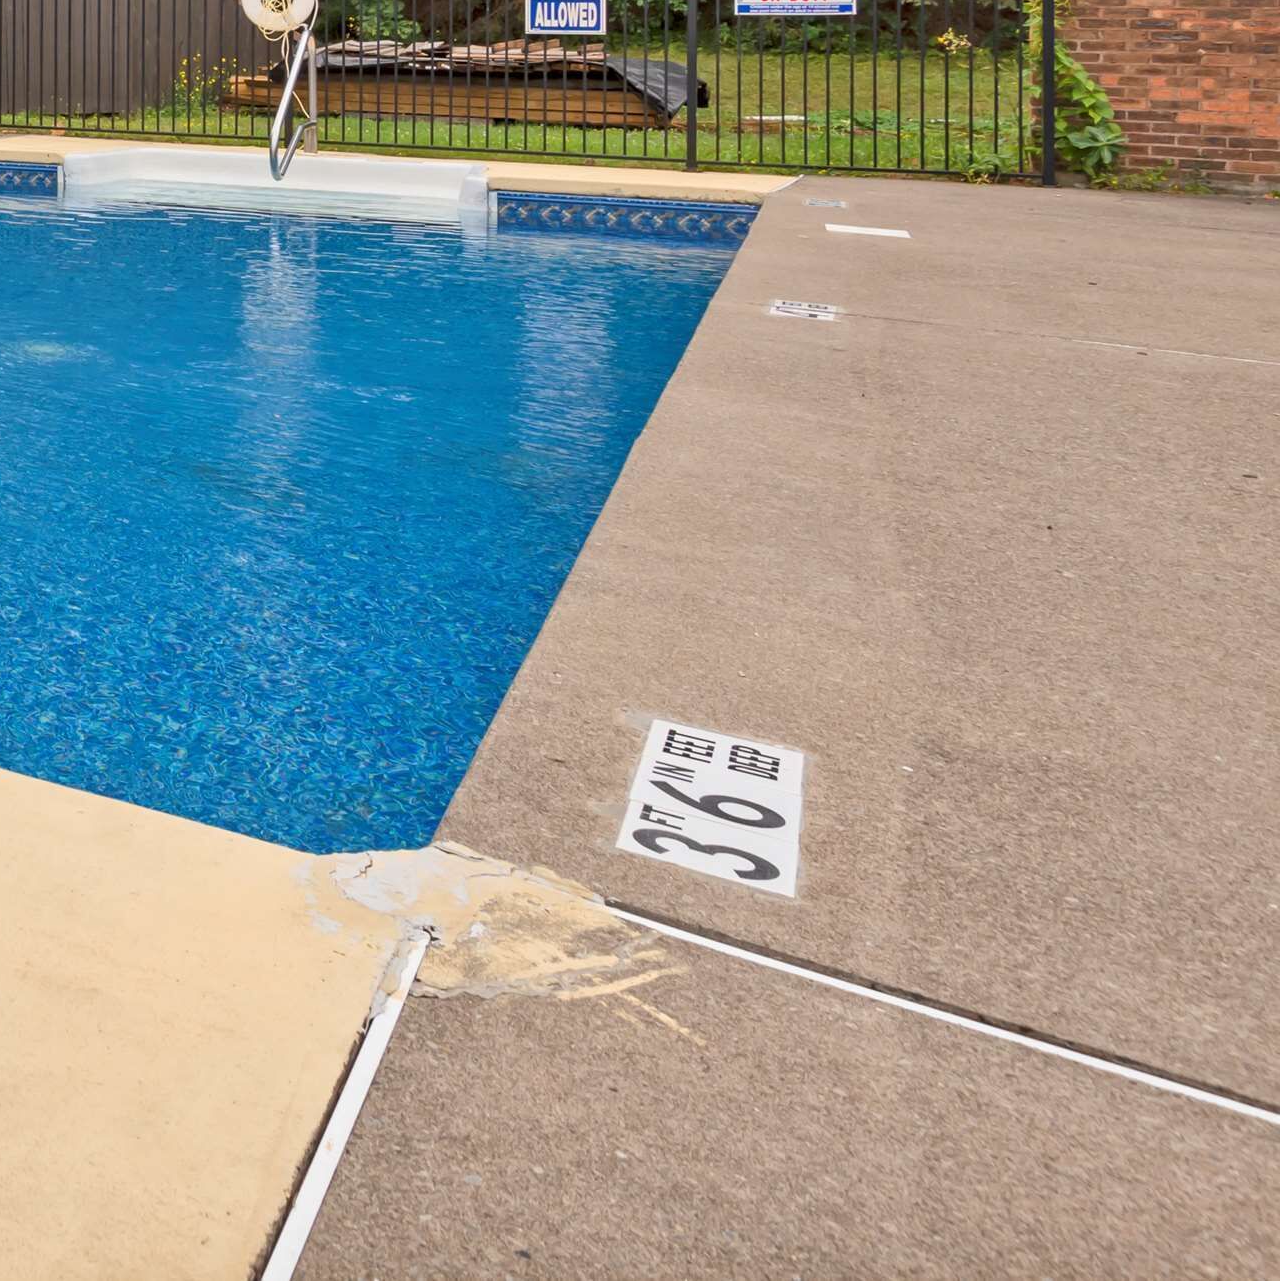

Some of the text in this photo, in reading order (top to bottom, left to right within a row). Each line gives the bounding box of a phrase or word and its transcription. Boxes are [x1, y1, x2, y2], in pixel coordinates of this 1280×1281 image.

[535, 2, 598, 28] ALLOWED
[662, 729, 716, 764] FEET
[727, 744, 781, 782] DEEP
[632, 760, 786, 881] 3 FT 6 IN
